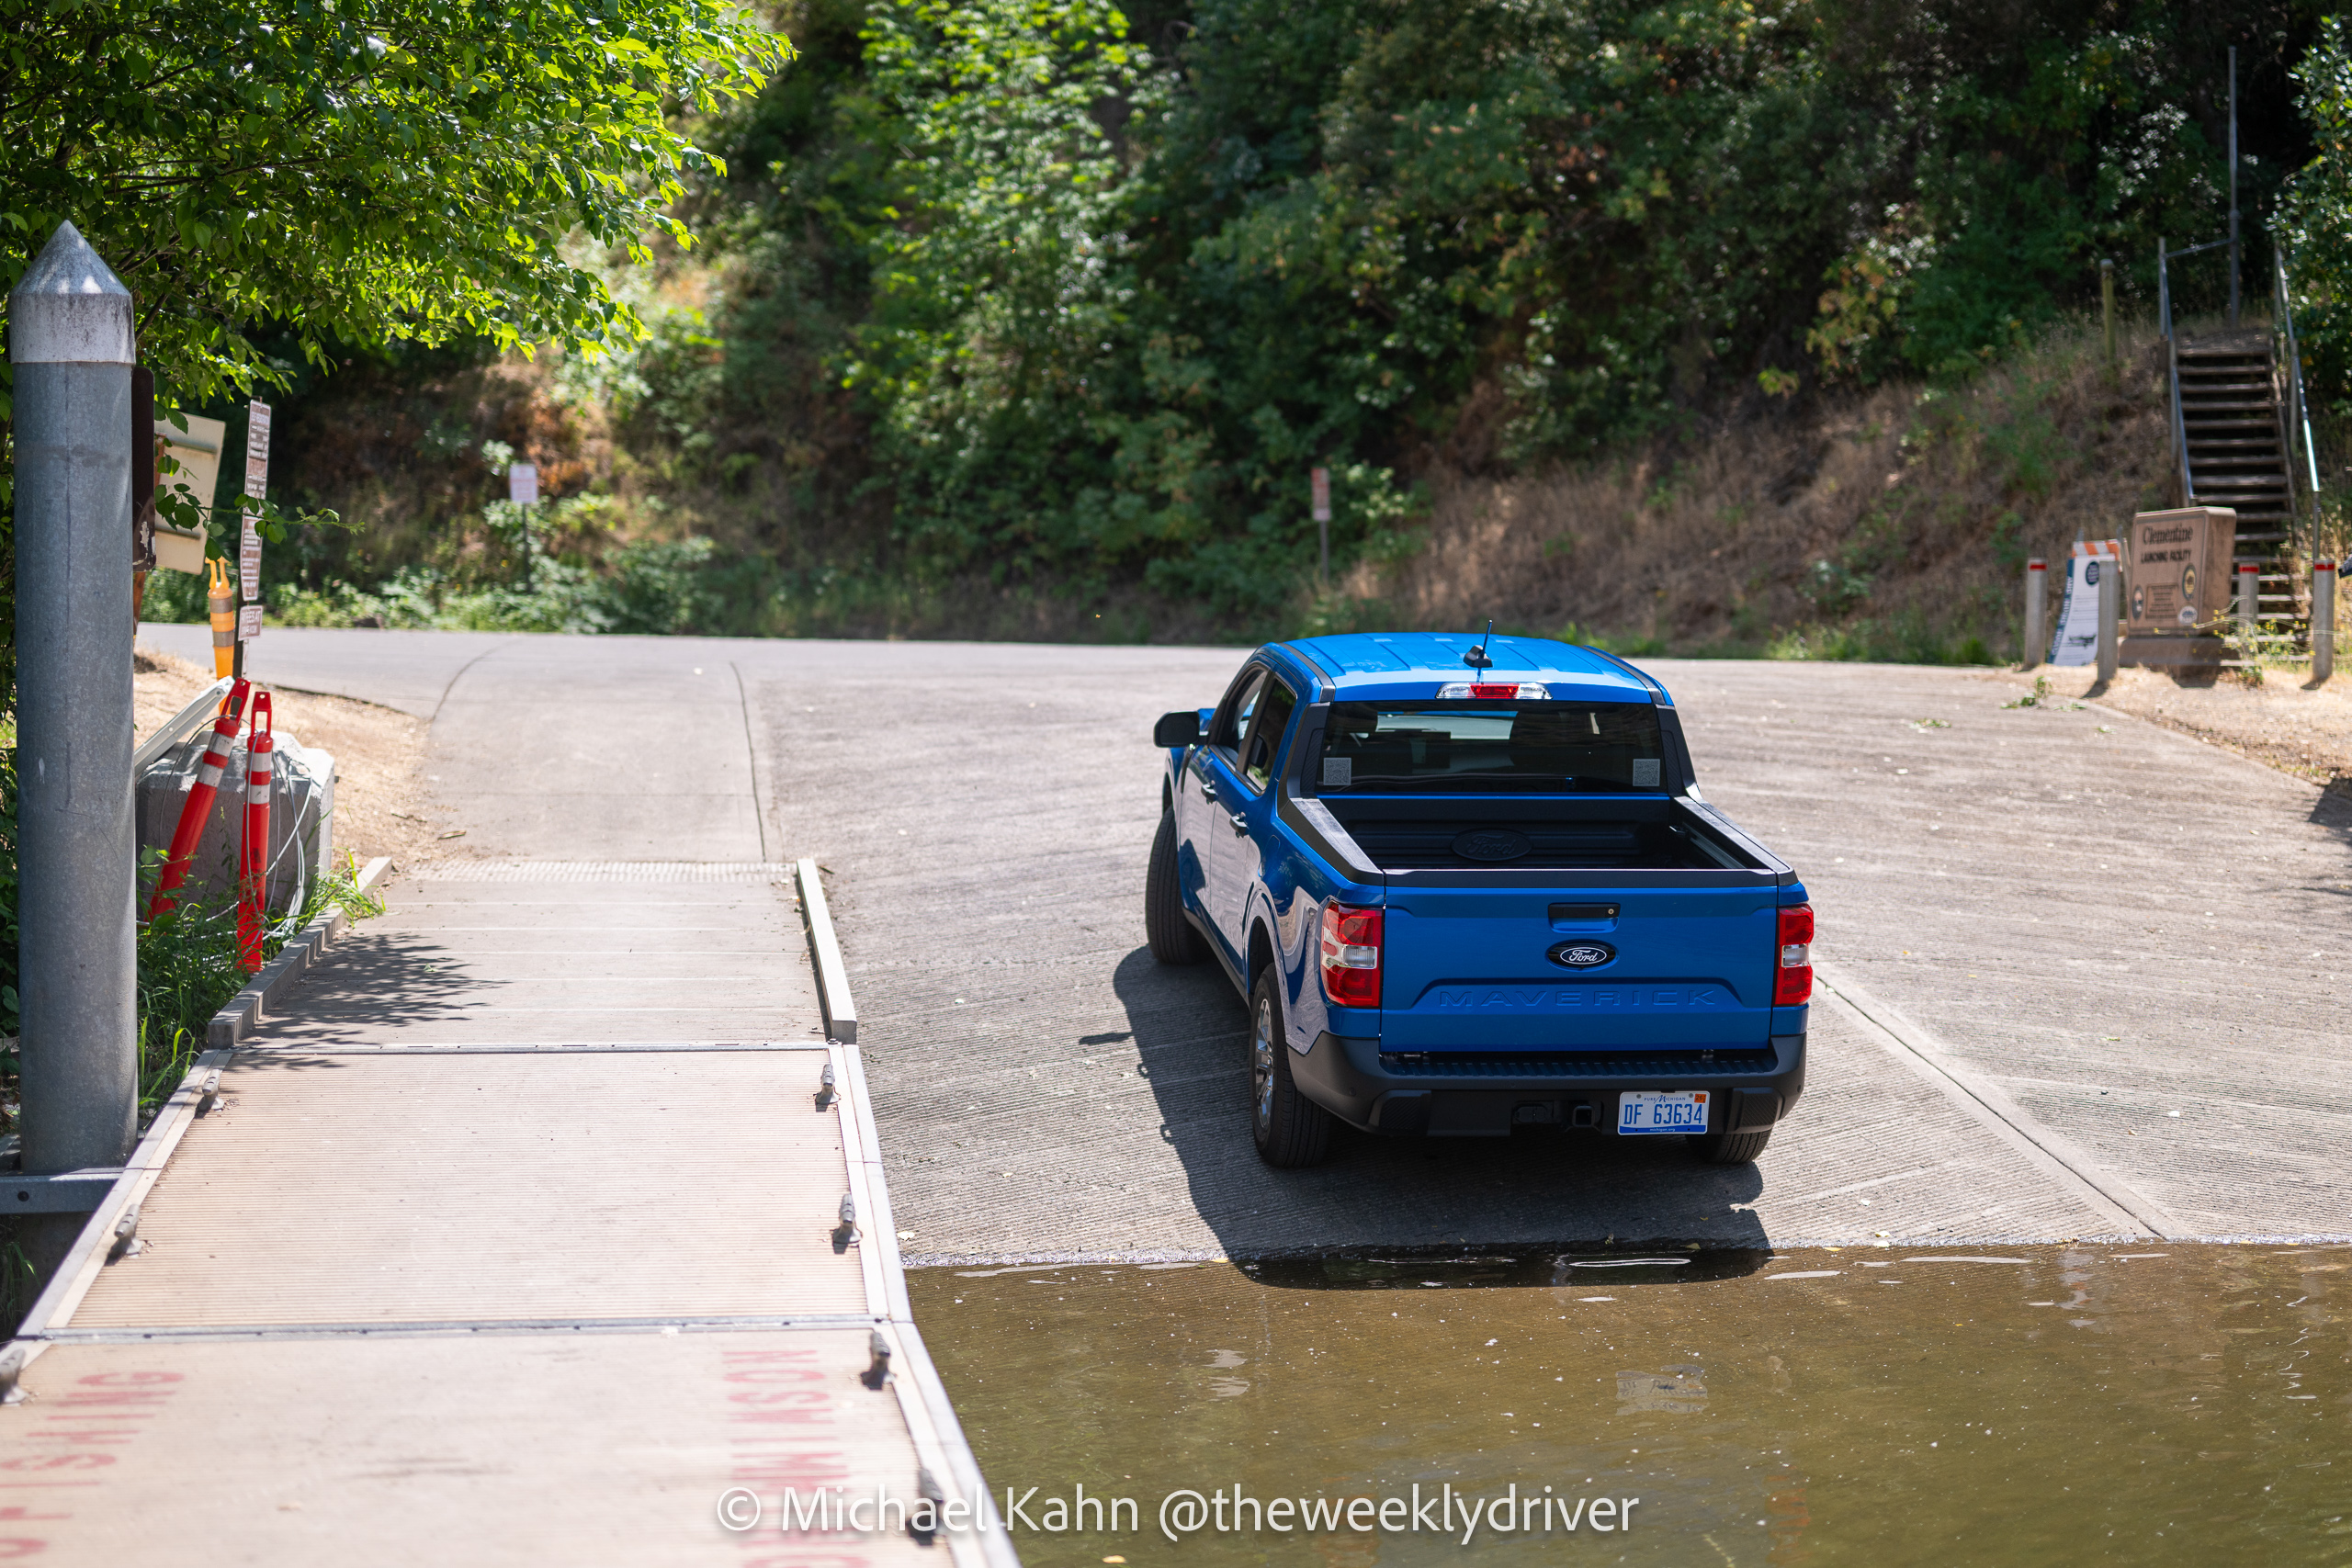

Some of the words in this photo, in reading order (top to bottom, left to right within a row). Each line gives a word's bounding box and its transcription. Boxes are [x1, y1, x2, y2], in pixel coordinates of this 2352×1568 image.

[1466, 833, 1516, 854] Ford
[1569, 949, 1599, 962] Ford
[1439, 990, 1715, 1007] MAVERICK
[1654, 1095, 1686, 1103] MICHIGAN
[1623, 1104, 1644, 1124] DF
[1654, 1103, 1702, 1124] 63634
